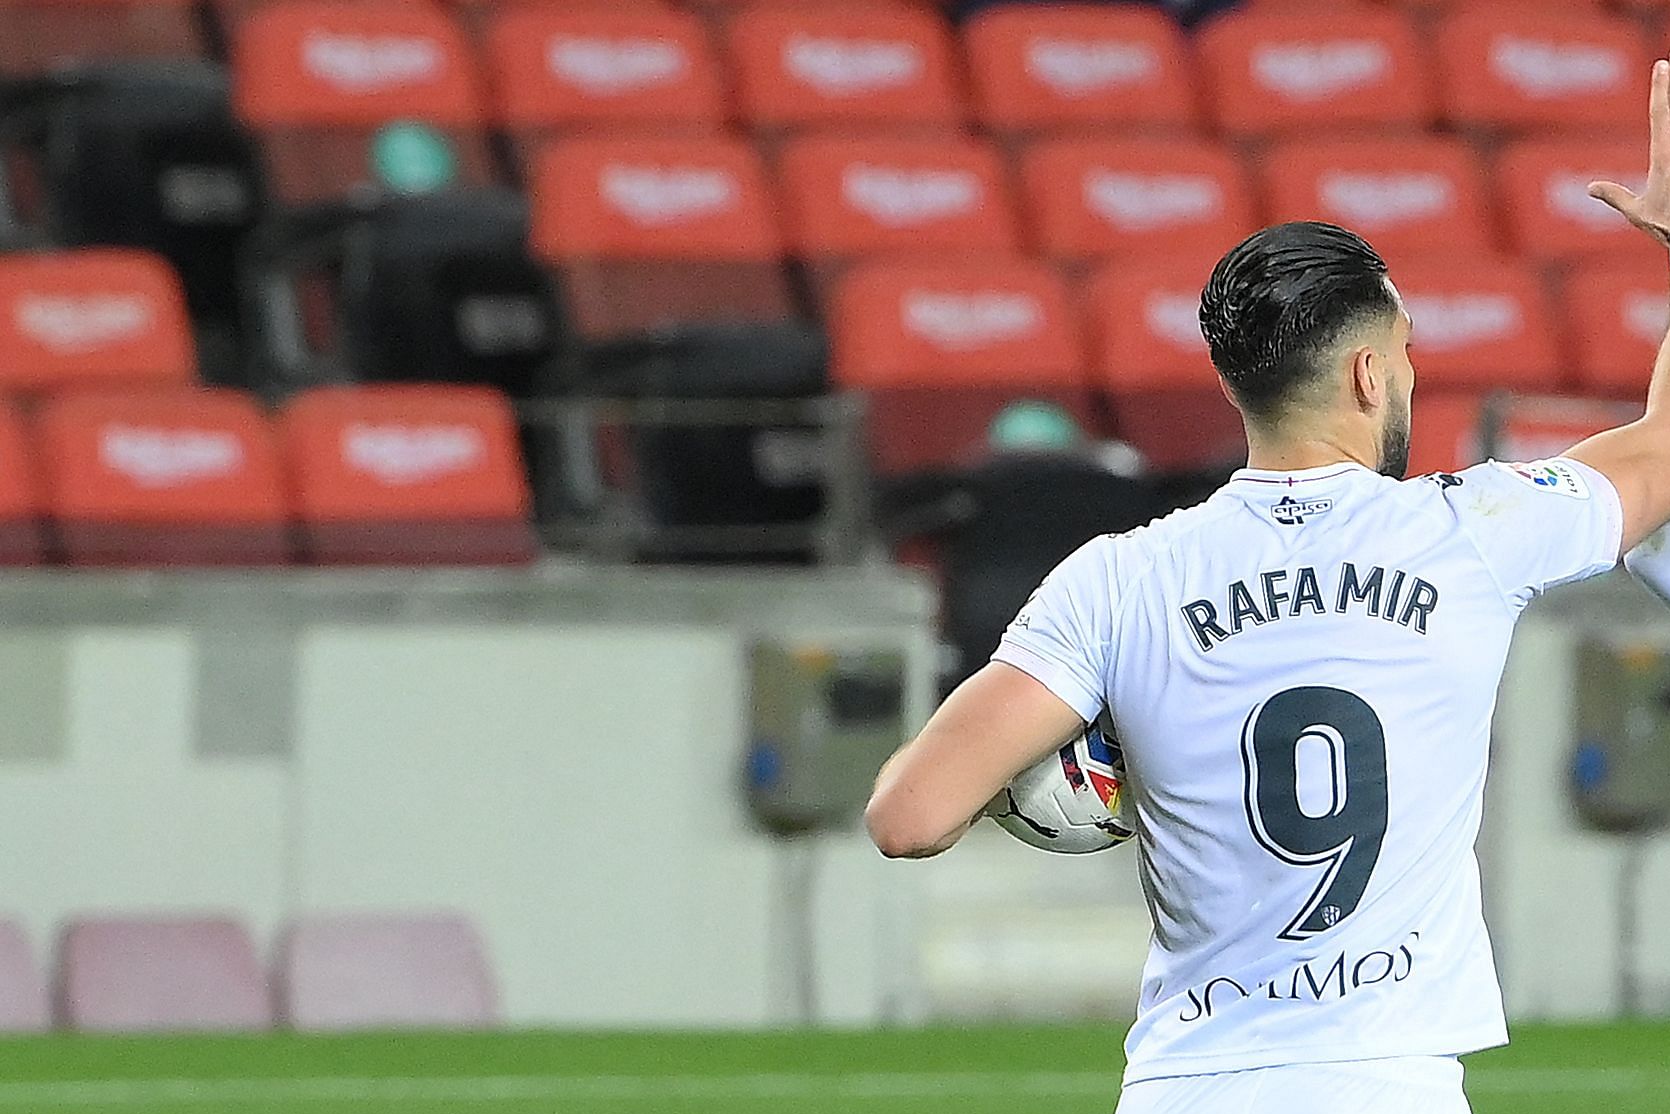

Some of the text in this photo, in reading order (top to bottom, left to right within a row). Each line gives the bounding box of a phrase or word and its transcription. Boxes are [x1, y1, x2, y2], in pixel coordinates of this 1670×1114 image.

[1181, 562, 1439, 653] RAFA MIR
[1239, 686, 1389, 941] 9
